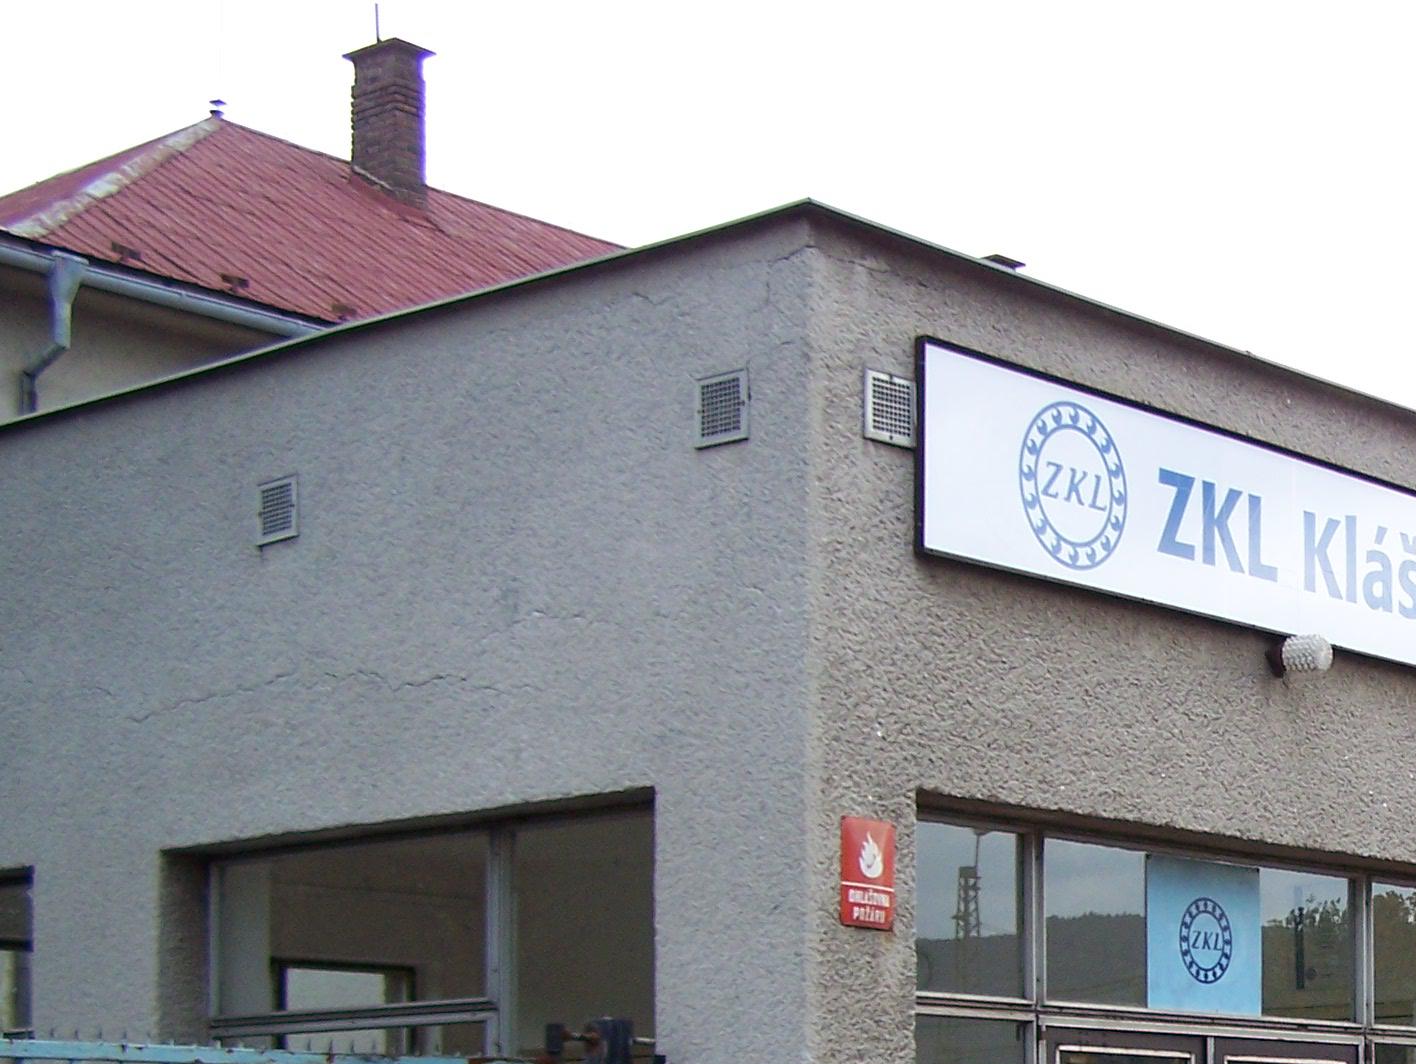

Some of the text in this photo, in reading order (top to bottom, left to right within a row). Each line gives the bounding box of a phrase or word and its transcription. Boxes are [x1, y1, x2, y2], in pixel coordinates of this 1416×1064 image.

[1040, 459, 1108, 513] ZKL
[1157, 466, 1279, 583] ZKL
[1191, 929, 1223, 952] ZKL
